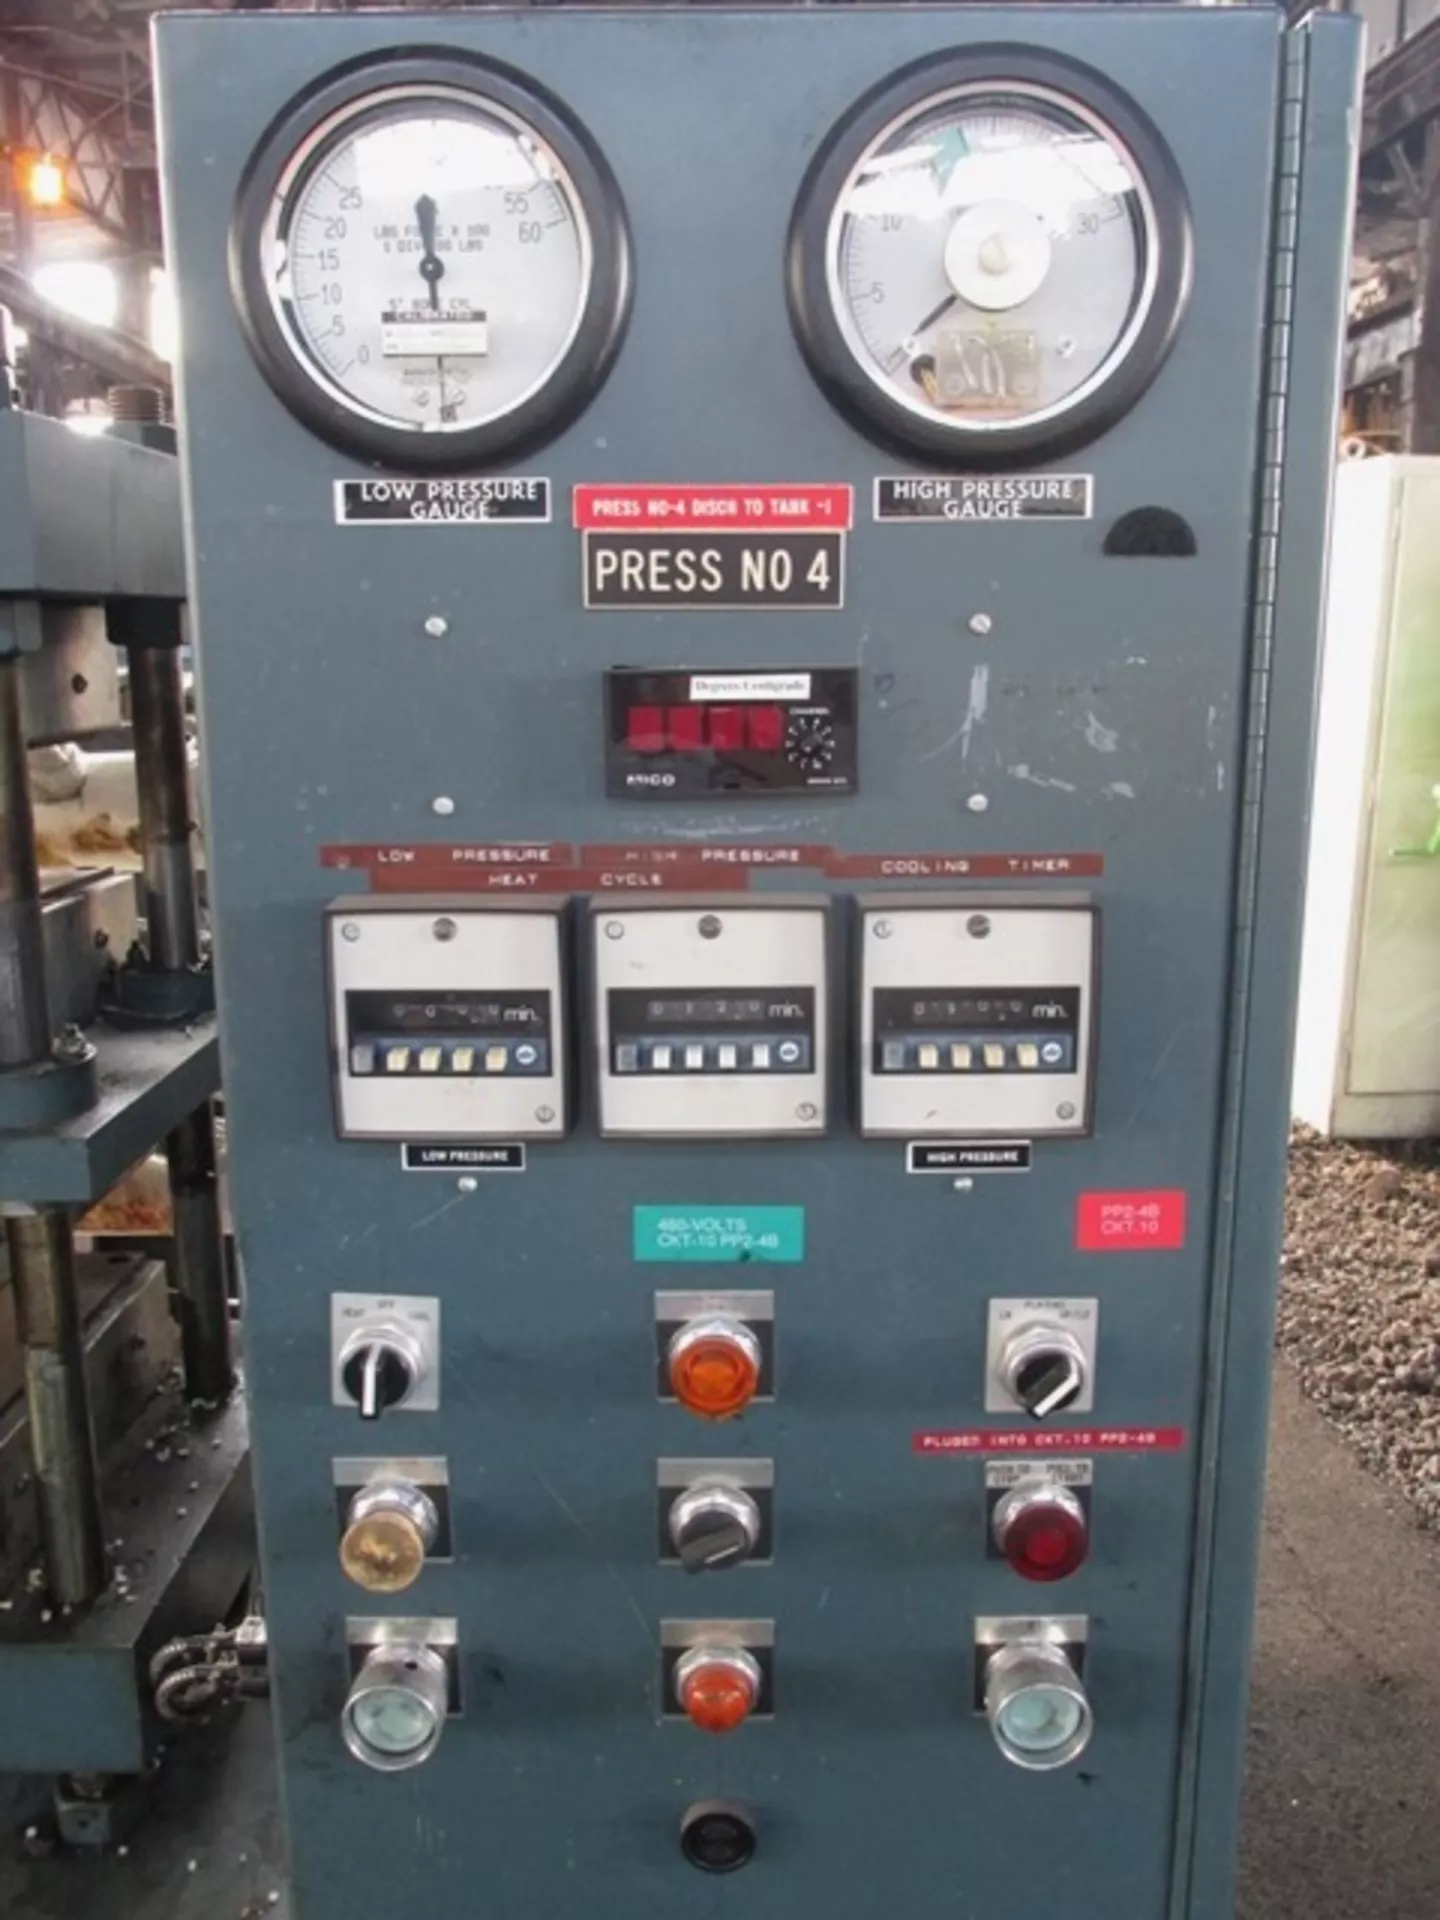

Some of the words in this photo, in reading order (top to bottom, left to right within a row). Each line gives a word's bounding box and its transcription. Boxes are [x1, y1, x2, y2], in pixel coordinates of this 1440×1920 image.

[339, 187, 363, 209] 25
[504, 193, 529, 215] 55
[324, 217, 346, 238] 20
[880, 213, 902, 232] 10
[1077, 213, 1099, 235] 30
[518, 222, 542, 244] 60
[317, 249, 340, 271] 15
[320, 284, 342, 306] 10
[871, 283, 885, 303] 5
[332, 315, 345, 336] 5
[357, 344, 370, 364] 0
[360, 481, 416, 501] LOW
[428, 480, 538, 500] PRESSURE
[893, 481, 950, 499] HIGH
[962, 480, 1072, 499] PRESSURE
[410, 500, 490, 519] GAUGE
[592, 498, 641, 517] PRESS
[943, 500, 1023, 519] GAUGE
[595, 549, 724, 592] PRESS
[740, 549, 794, 592] NO
[805, 549, 831, 592] 4
[376, 850, 415, 863] LOW
[452, 849, 551, 862] PRESSURE
[701, 848, 800, 862] PRESSURE
[881, 860, 970, 874] COOLING
[1008, 858, 1071, 872] TIMER
[488, 873, 538, 887] HEAT
[600, 872, 663, 887] CYCLE
[422, 1151, 449, 1163] LOW
[450, 1150, 510, 1163] PRESSURE
[927, 1151, 957, 1164] HIGH
[959, 1150, 1020, 1163] PRESSURE
[990, 1433, 1028, 1447] INTO
